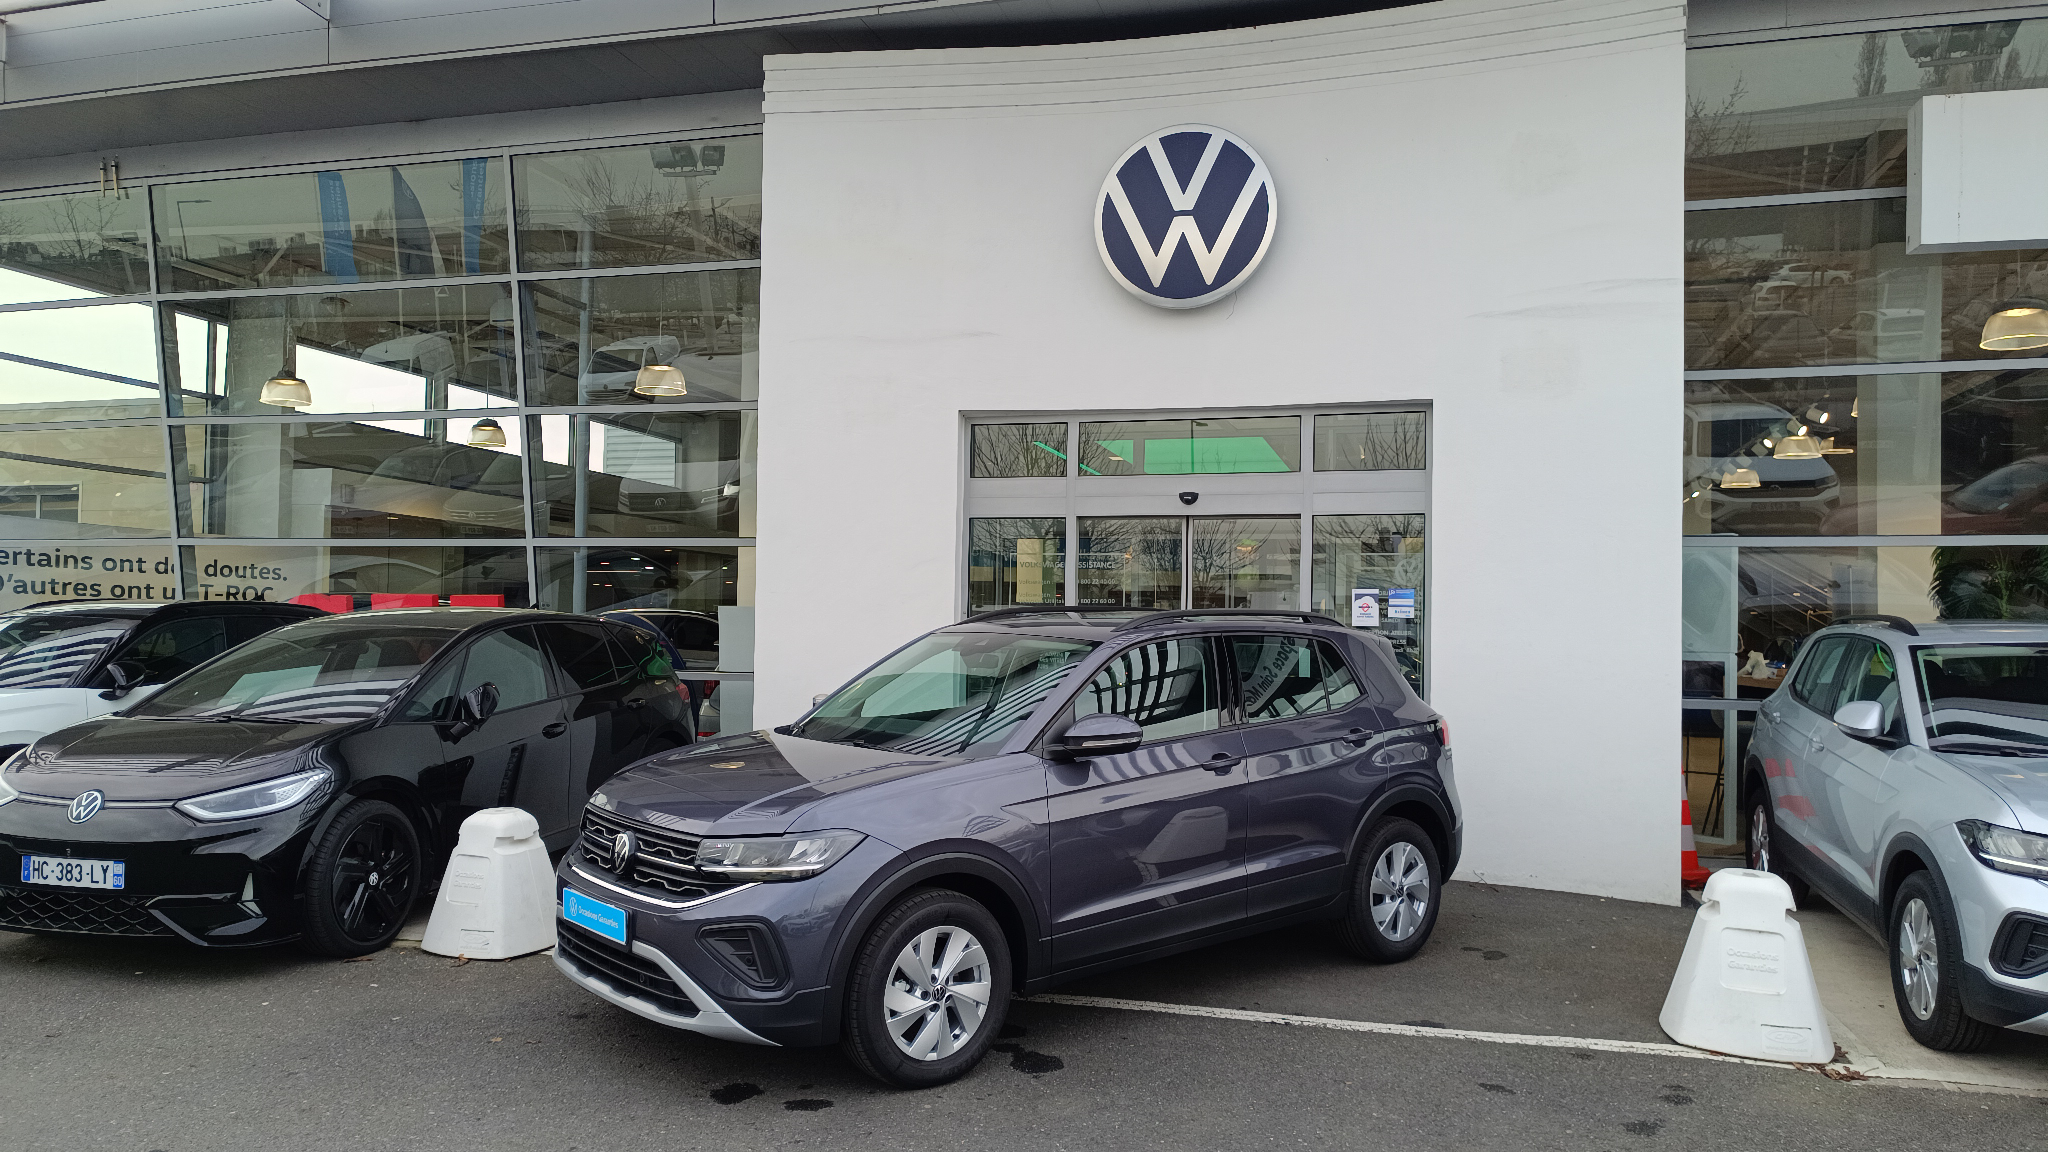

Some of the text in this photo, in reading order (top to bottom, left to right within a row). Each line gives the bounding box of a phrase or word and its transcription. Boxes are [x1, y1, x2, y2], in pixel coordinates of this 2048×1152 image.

[102, 557, 147, 573] ont
[204, 559, 288, 581] doutes.
[1019, 561, 1116, 569] VOLKSWAGE SSISTANCE
[110, 583, 155, 599] ont
[163, 586, 176, 600] u
[199, 584, 274, 601] T-ROC
[32, 860, 110, 884] HC-383-LY
[113, 876, 123, 886] 60
[578, 905, 598, 921] Occasions
[1727, 947, 1780, 962] Occasions
